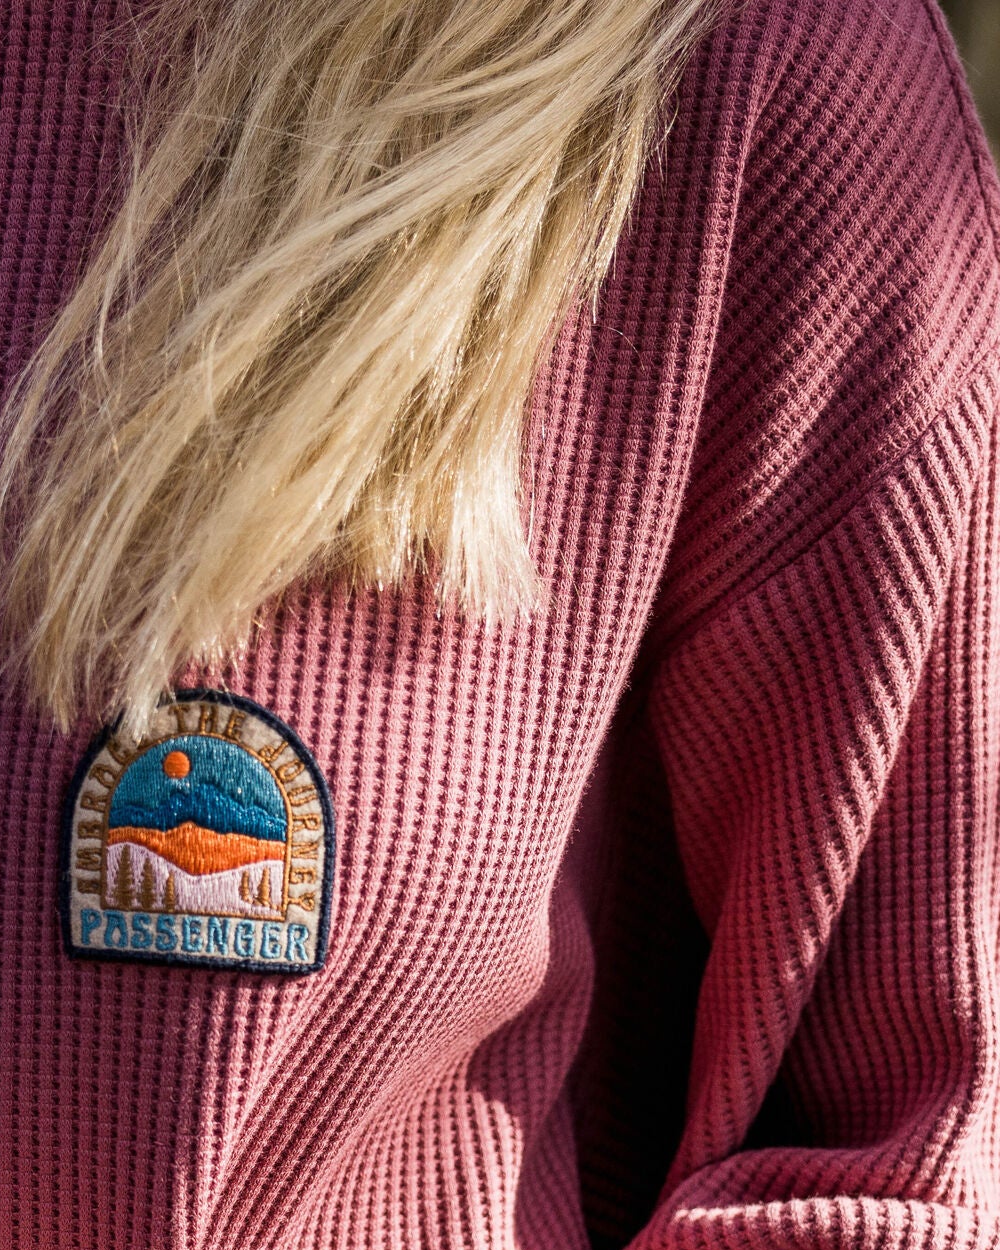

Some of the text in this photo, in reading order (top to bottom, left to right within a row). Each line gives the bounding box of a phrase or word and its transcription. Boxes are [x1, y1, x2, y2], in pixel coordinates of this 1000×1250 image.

[75, 703, 321, 912] EMBRAC THE JOURNEY
[80, 908, 310, 961] PASSENGER
